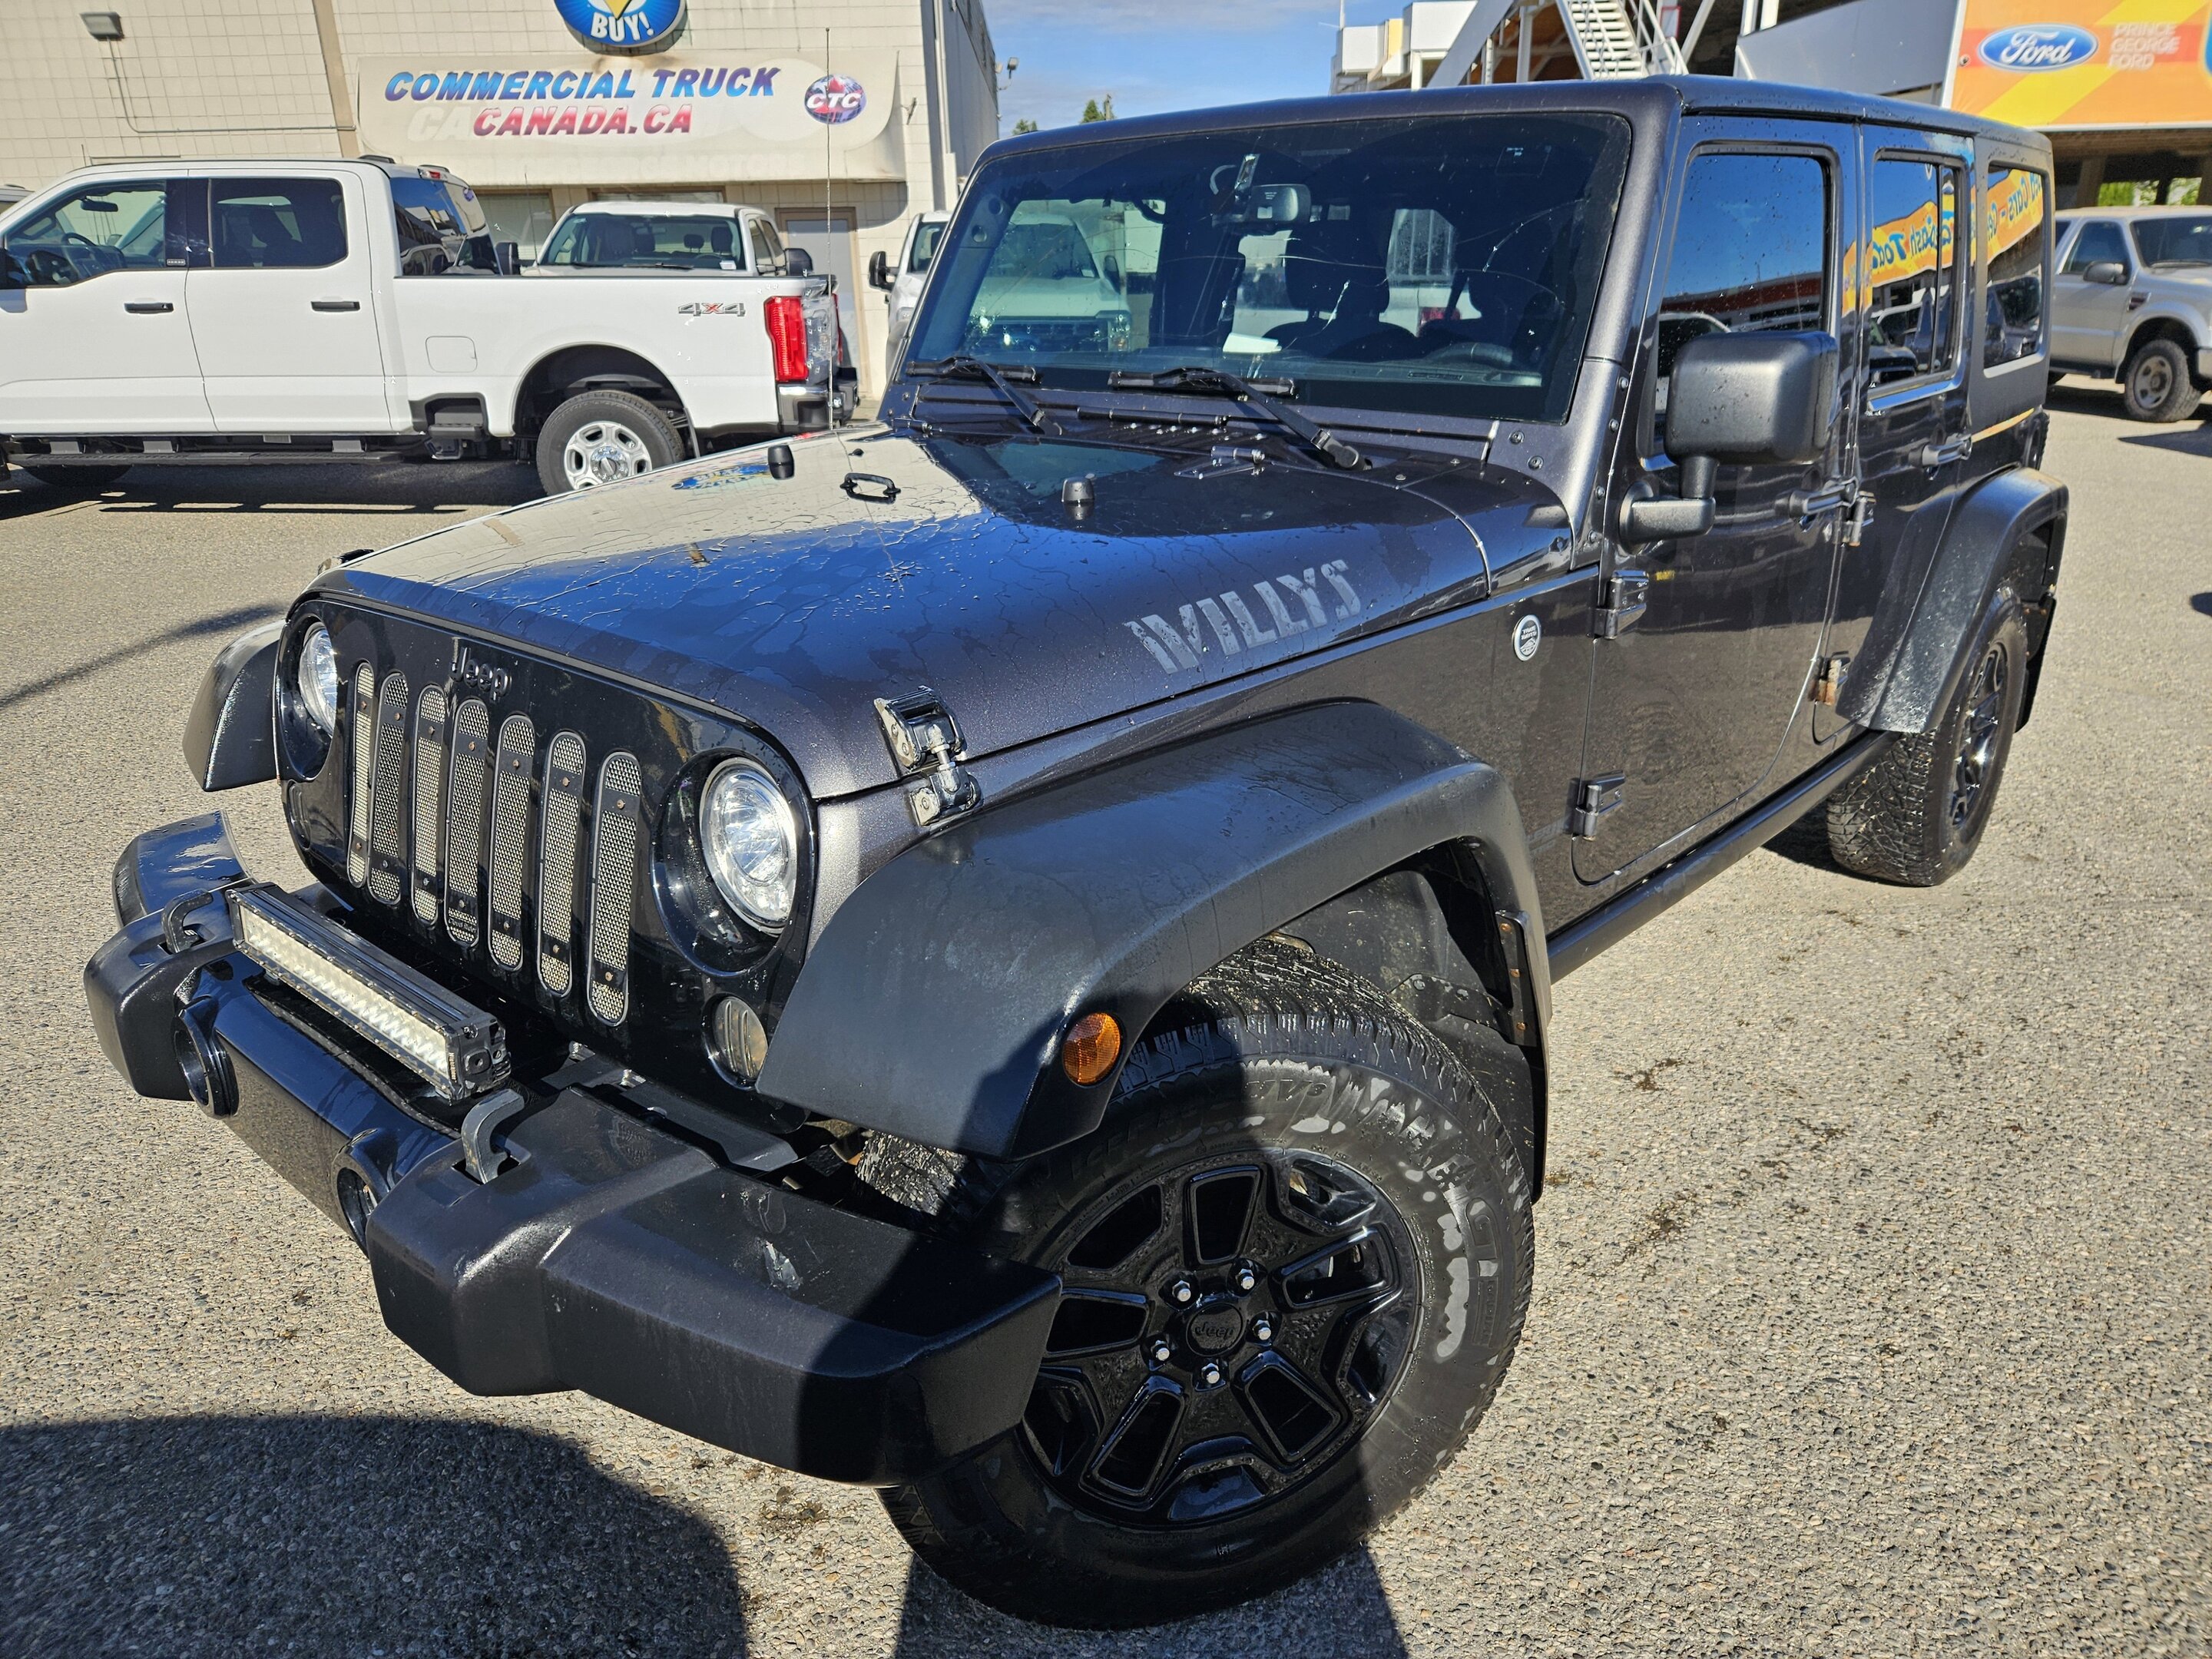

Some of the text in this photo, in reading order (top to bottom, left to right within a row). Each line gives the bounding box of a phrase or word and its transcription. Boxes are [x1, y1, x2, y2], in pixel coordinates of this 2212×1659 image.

[591, 12, 654, 41] BUY!
[2114, 22, 2177, 37] PRINCE
[2000, 30, 2077, 65] Ford
[2111, 36, 2181, 54] GEORGE
[2108, 54, 2154, 69] FORD
[384, 67, 781, 101] COMMERCIAL TRUCK
[806, 92, 861, 108] CTC
[473, 104, 693, 137] CANADA.CA
[1122, 558, 1361, 674] WILLYS
[448, 647, 512, 704] Jeep
[1195, 1321, 1233, 1339] Jeep
